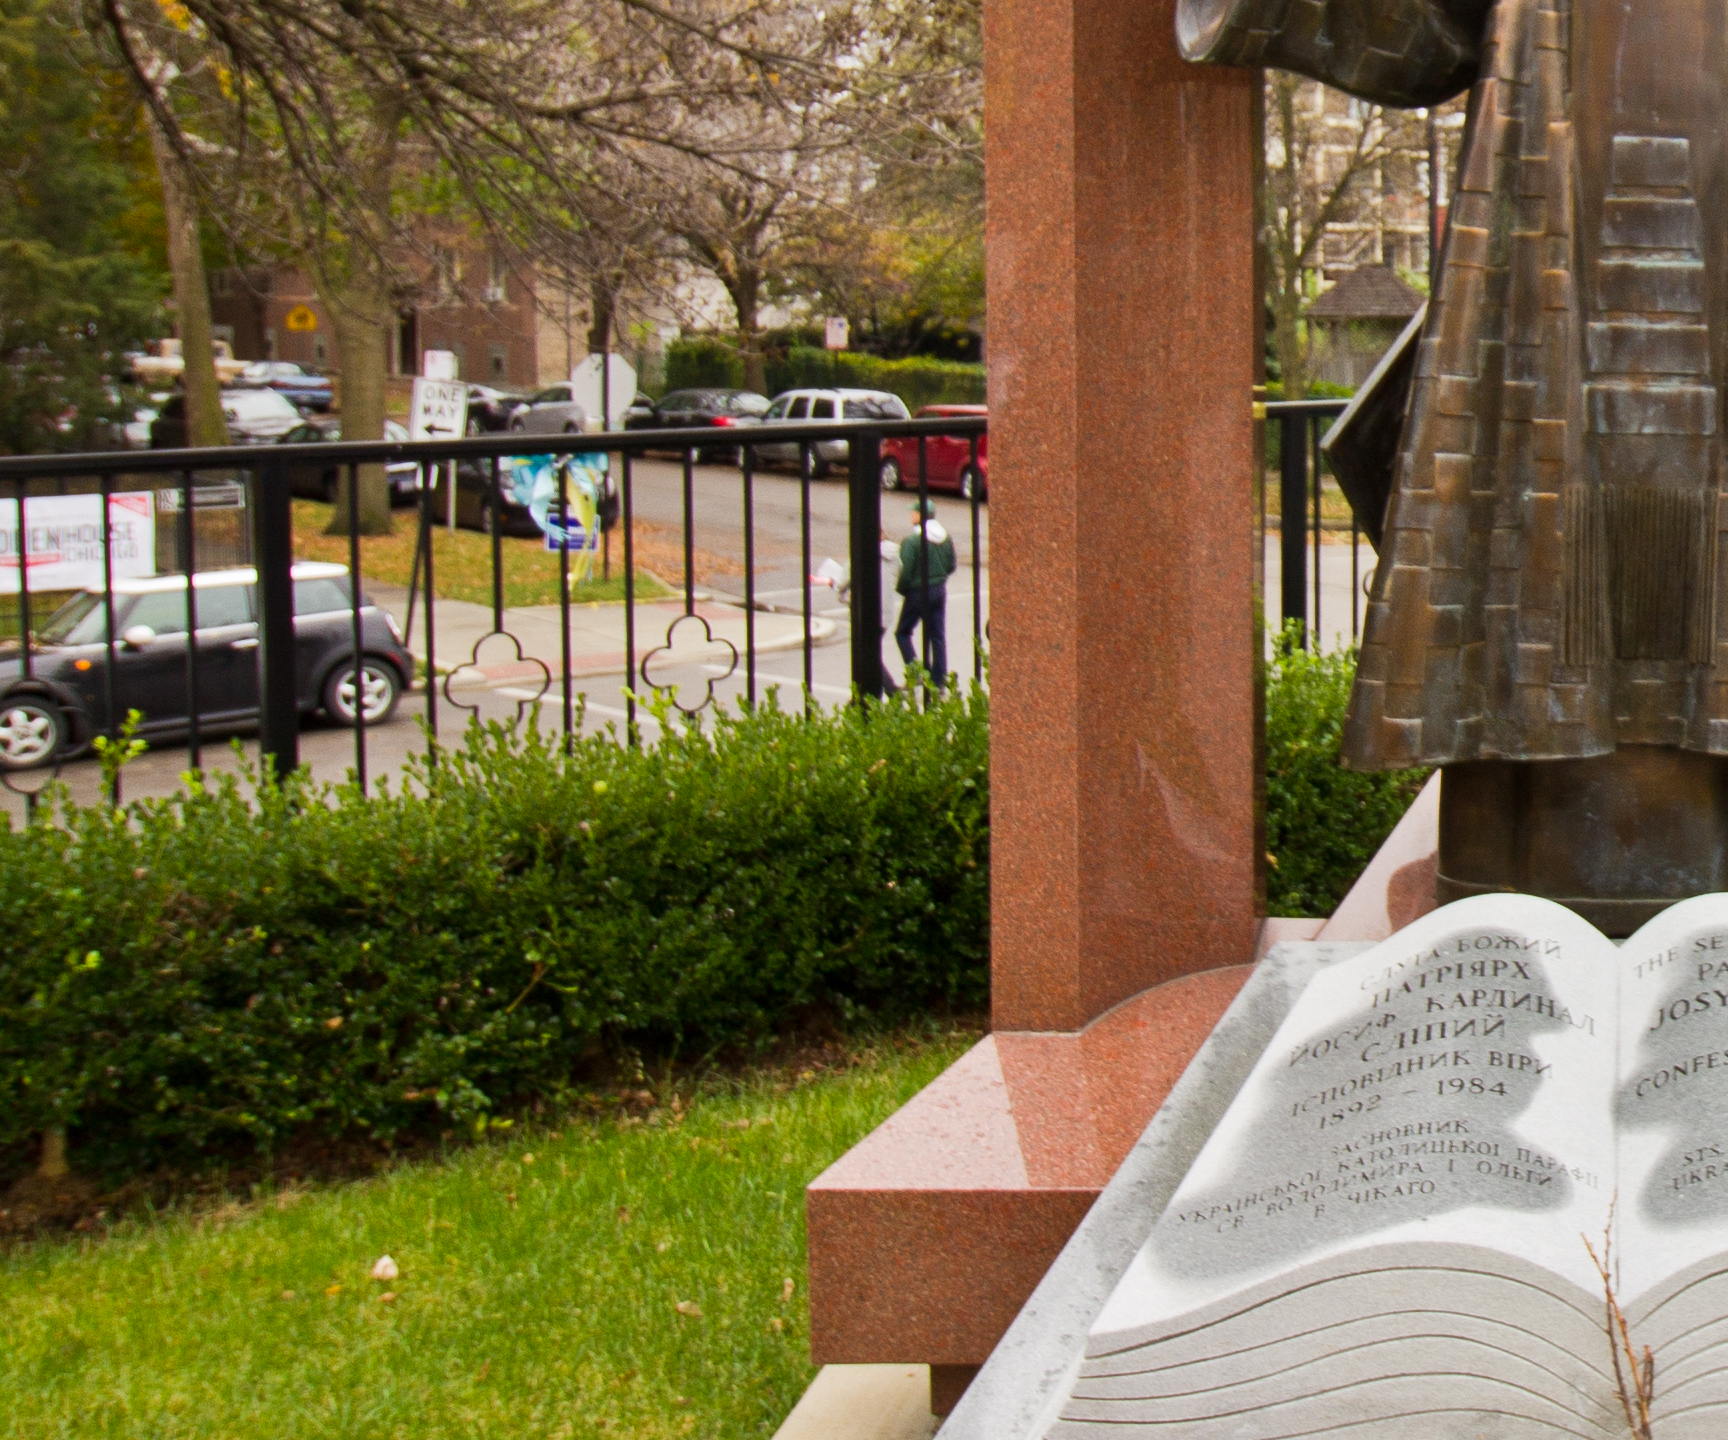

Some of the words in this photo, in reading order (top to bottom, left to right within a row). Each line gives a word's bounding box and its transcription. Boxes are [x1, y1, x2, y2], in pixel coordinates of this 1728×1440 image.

[424, 385, 460, 402] ONE
[424, 404, 457, 418] WAY
[63, 540, 138, 562] CHICGO
[1457, 935, 1562, 959] БОЖИЙ
[1634, 946, 1680, 978] THE
[1371, 959, 1531, 1009] ПАТРІЯРХ
[1425, 988, 1596, 1037] КАРДИНАЛ
[1360, 1013, 1506, 1062] СЛІПИЙ
[1488, 1050, 1554, 1079] ВІРИ
[1319, 1093, 1382, 1130] 1892
[1436, 1077, 1509, 1097] 1984
[1476, 1160, 1553, 1188] ОЛЬГИ
[1348, 1180, 1436, 1204] ЧІКАГО
